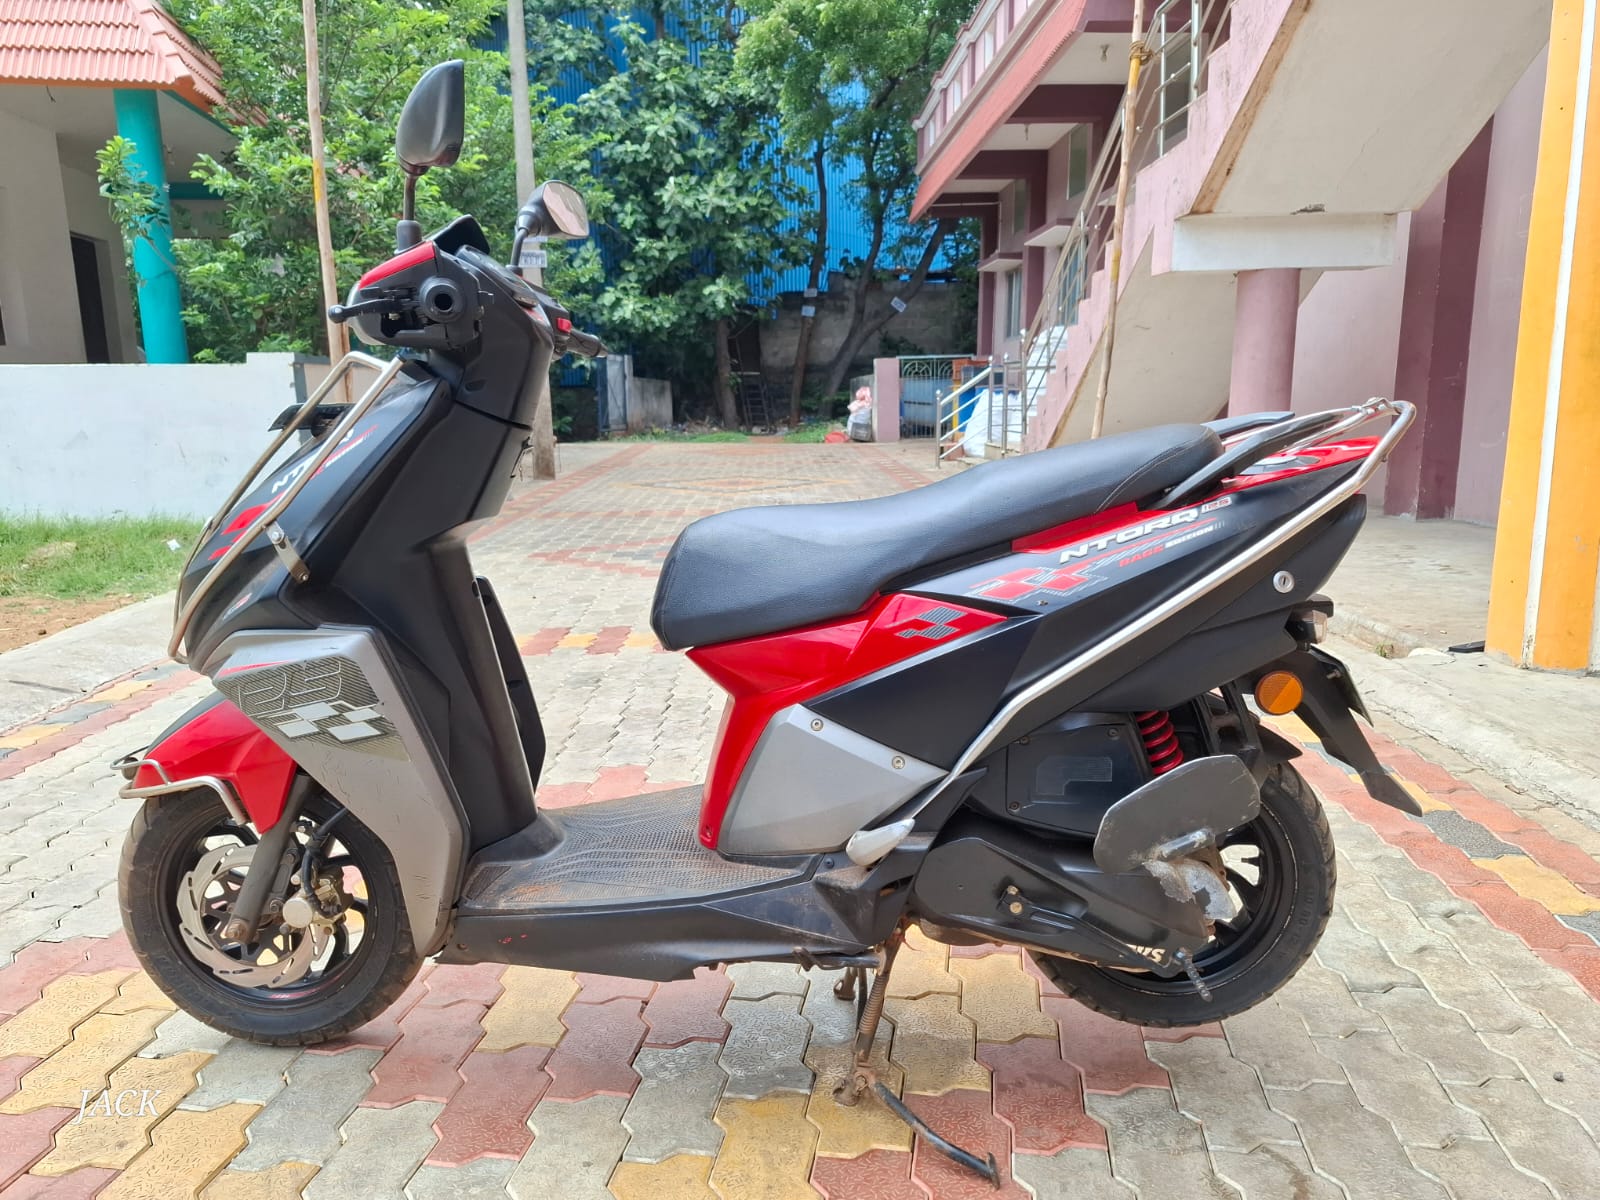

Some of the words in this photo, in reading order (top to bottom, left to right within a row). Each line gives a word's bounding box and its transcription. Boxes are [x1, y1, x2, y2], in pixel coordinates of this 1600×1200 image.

[1058, 508, 1199, 564] NTORQ
[1202, 497, 1231, 513] 125
[1118, 544, 1165, 567] RACE
[1165, 523, 1214, 549] EDITION
